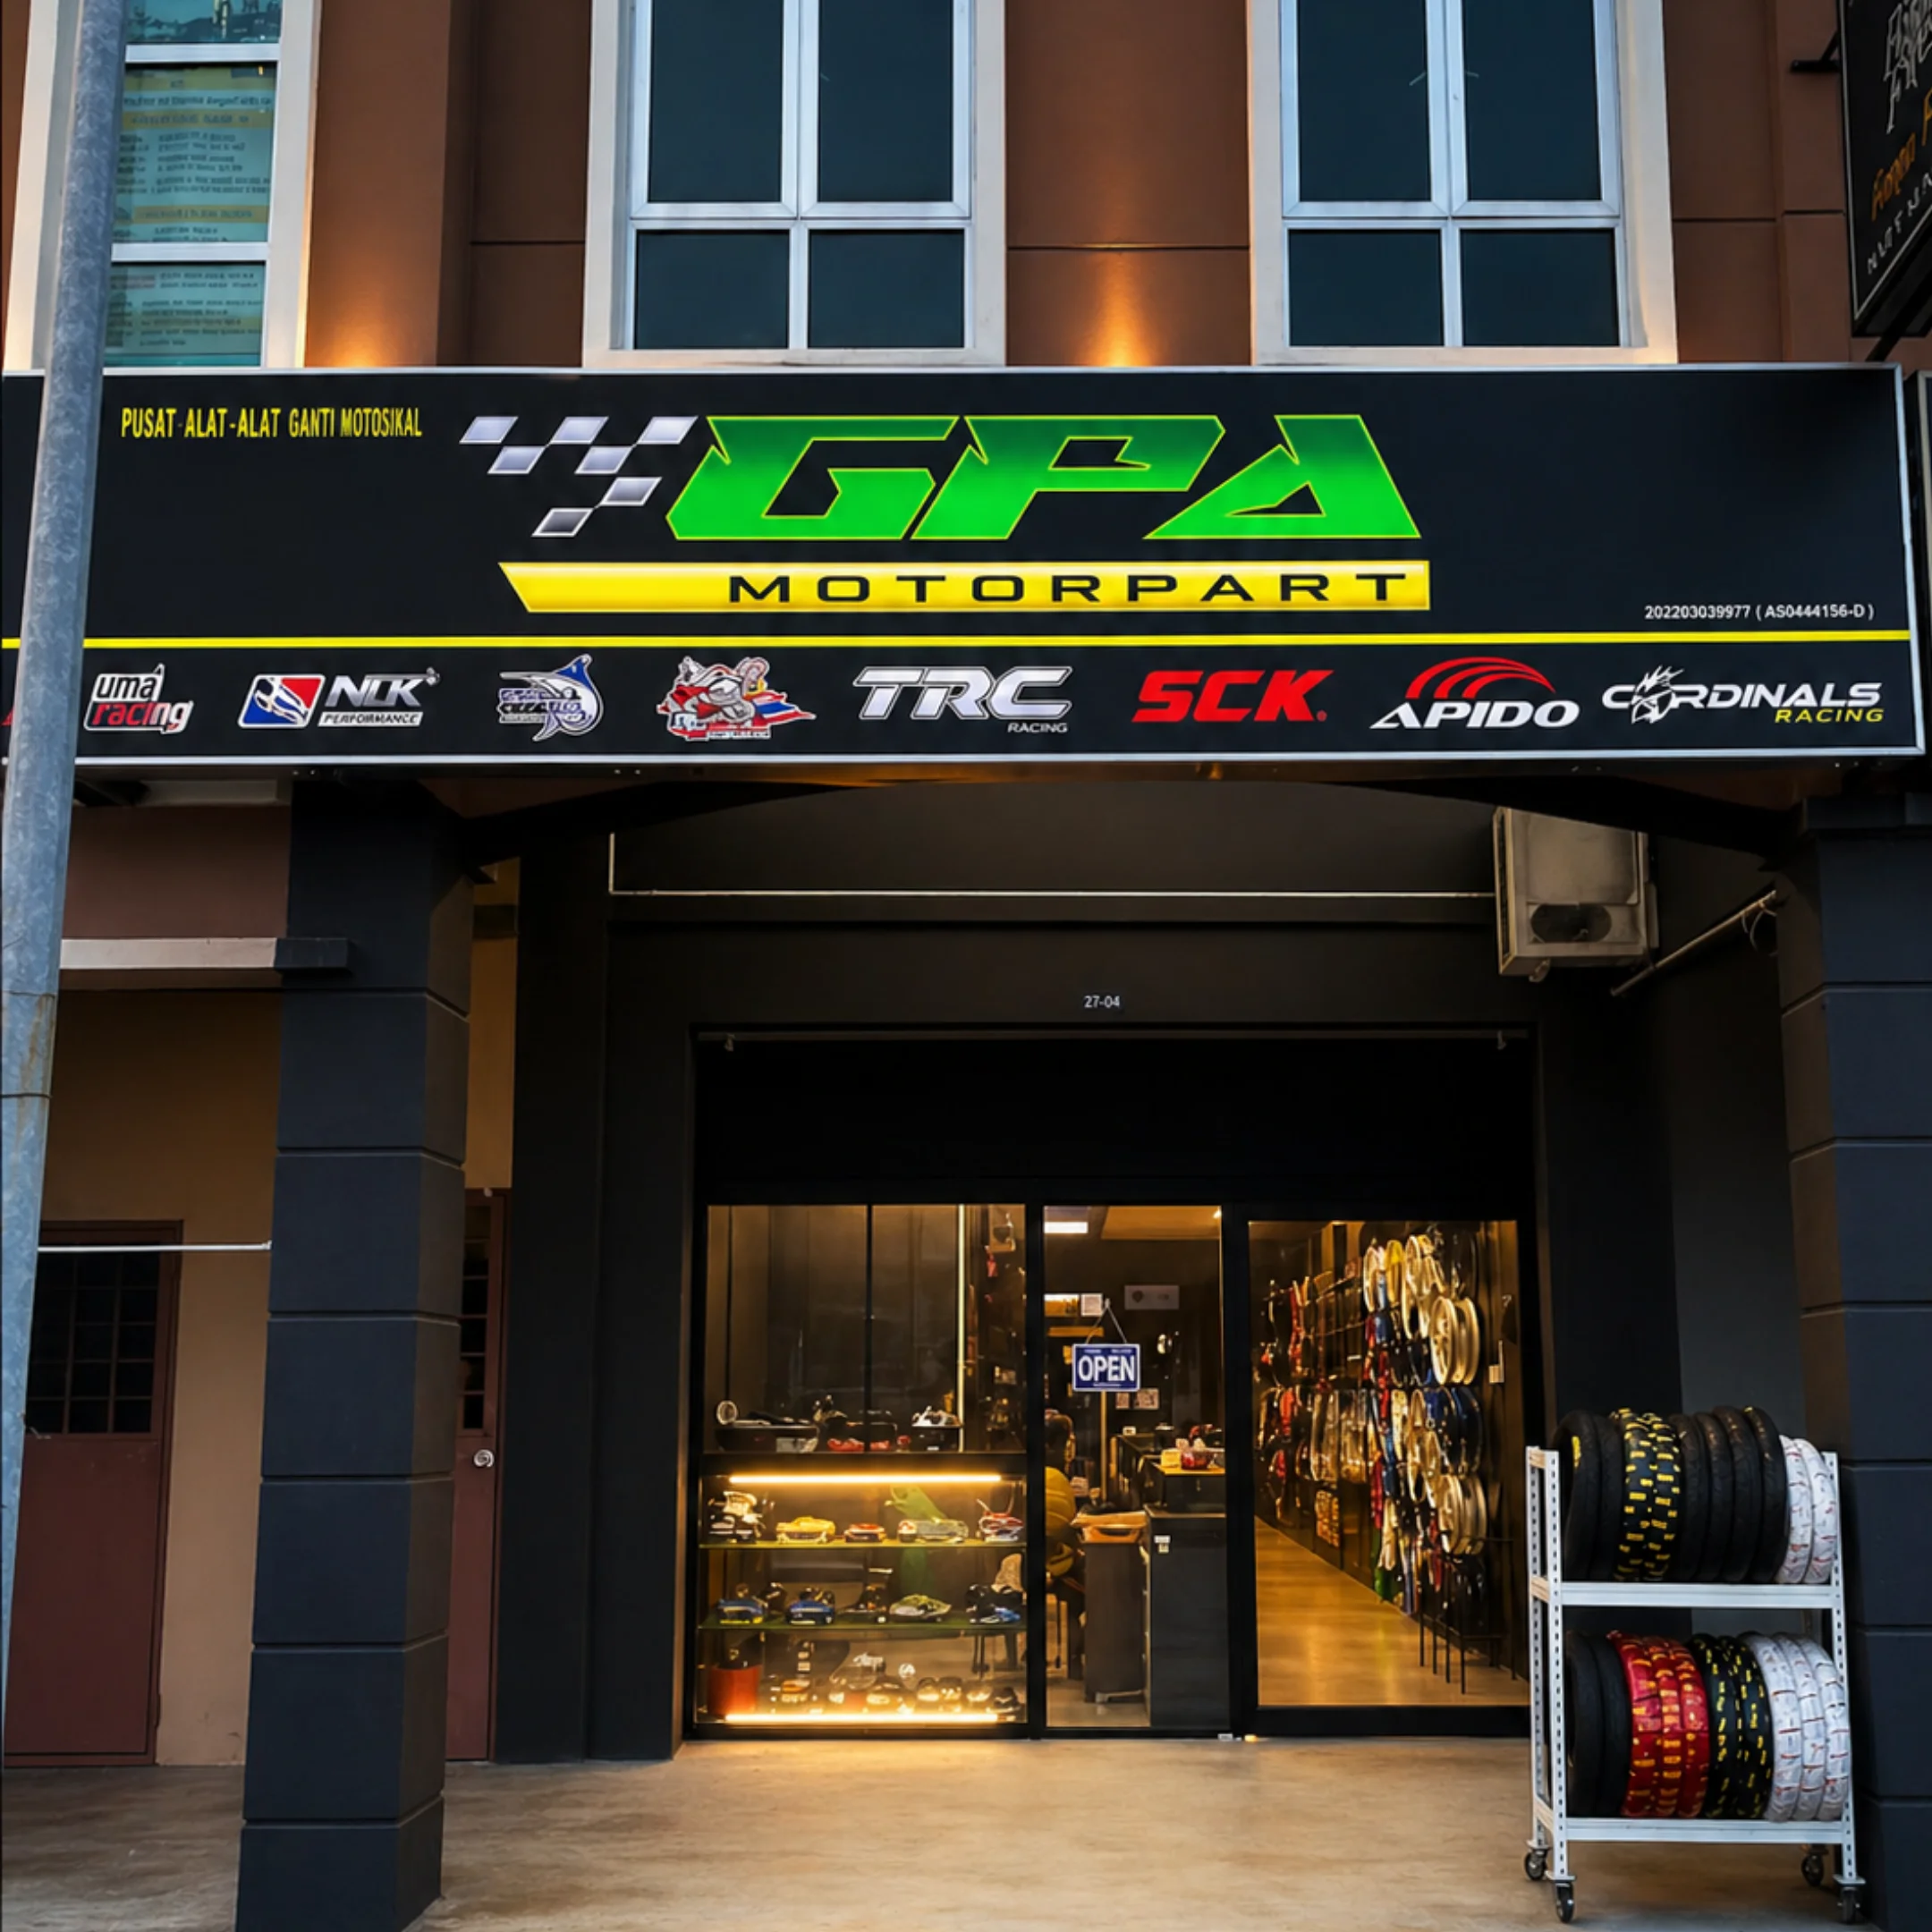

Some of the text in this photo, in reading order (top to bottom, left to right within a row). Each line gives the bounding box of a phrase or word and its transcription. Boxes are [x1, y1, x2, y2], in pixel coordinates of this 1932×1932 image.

[120, 407, 177, 437] PUSAT
[288, 408, 335, 436] GANTI
[340, 408, 423, 436] MOTOSIKAL
[665, 415, 1422, 540] GPA
[728, 572, 1408, 604] MOTORPART
[1644, 604, 1751, 620] 202203039977
[95, 674, 158, 700] uma
[852, 665, 1073, 721] TRC
[90, 700, 194, 732] racing
[1007, 722, 1070, 733] RACING
[1368, 699, 1580, 730] APIDO
[1775, 708, 1885, 724] RACING
[1083, 994, 1121, 1009] 27-04
[1078, 1354, 1136, 1382] OPEN
